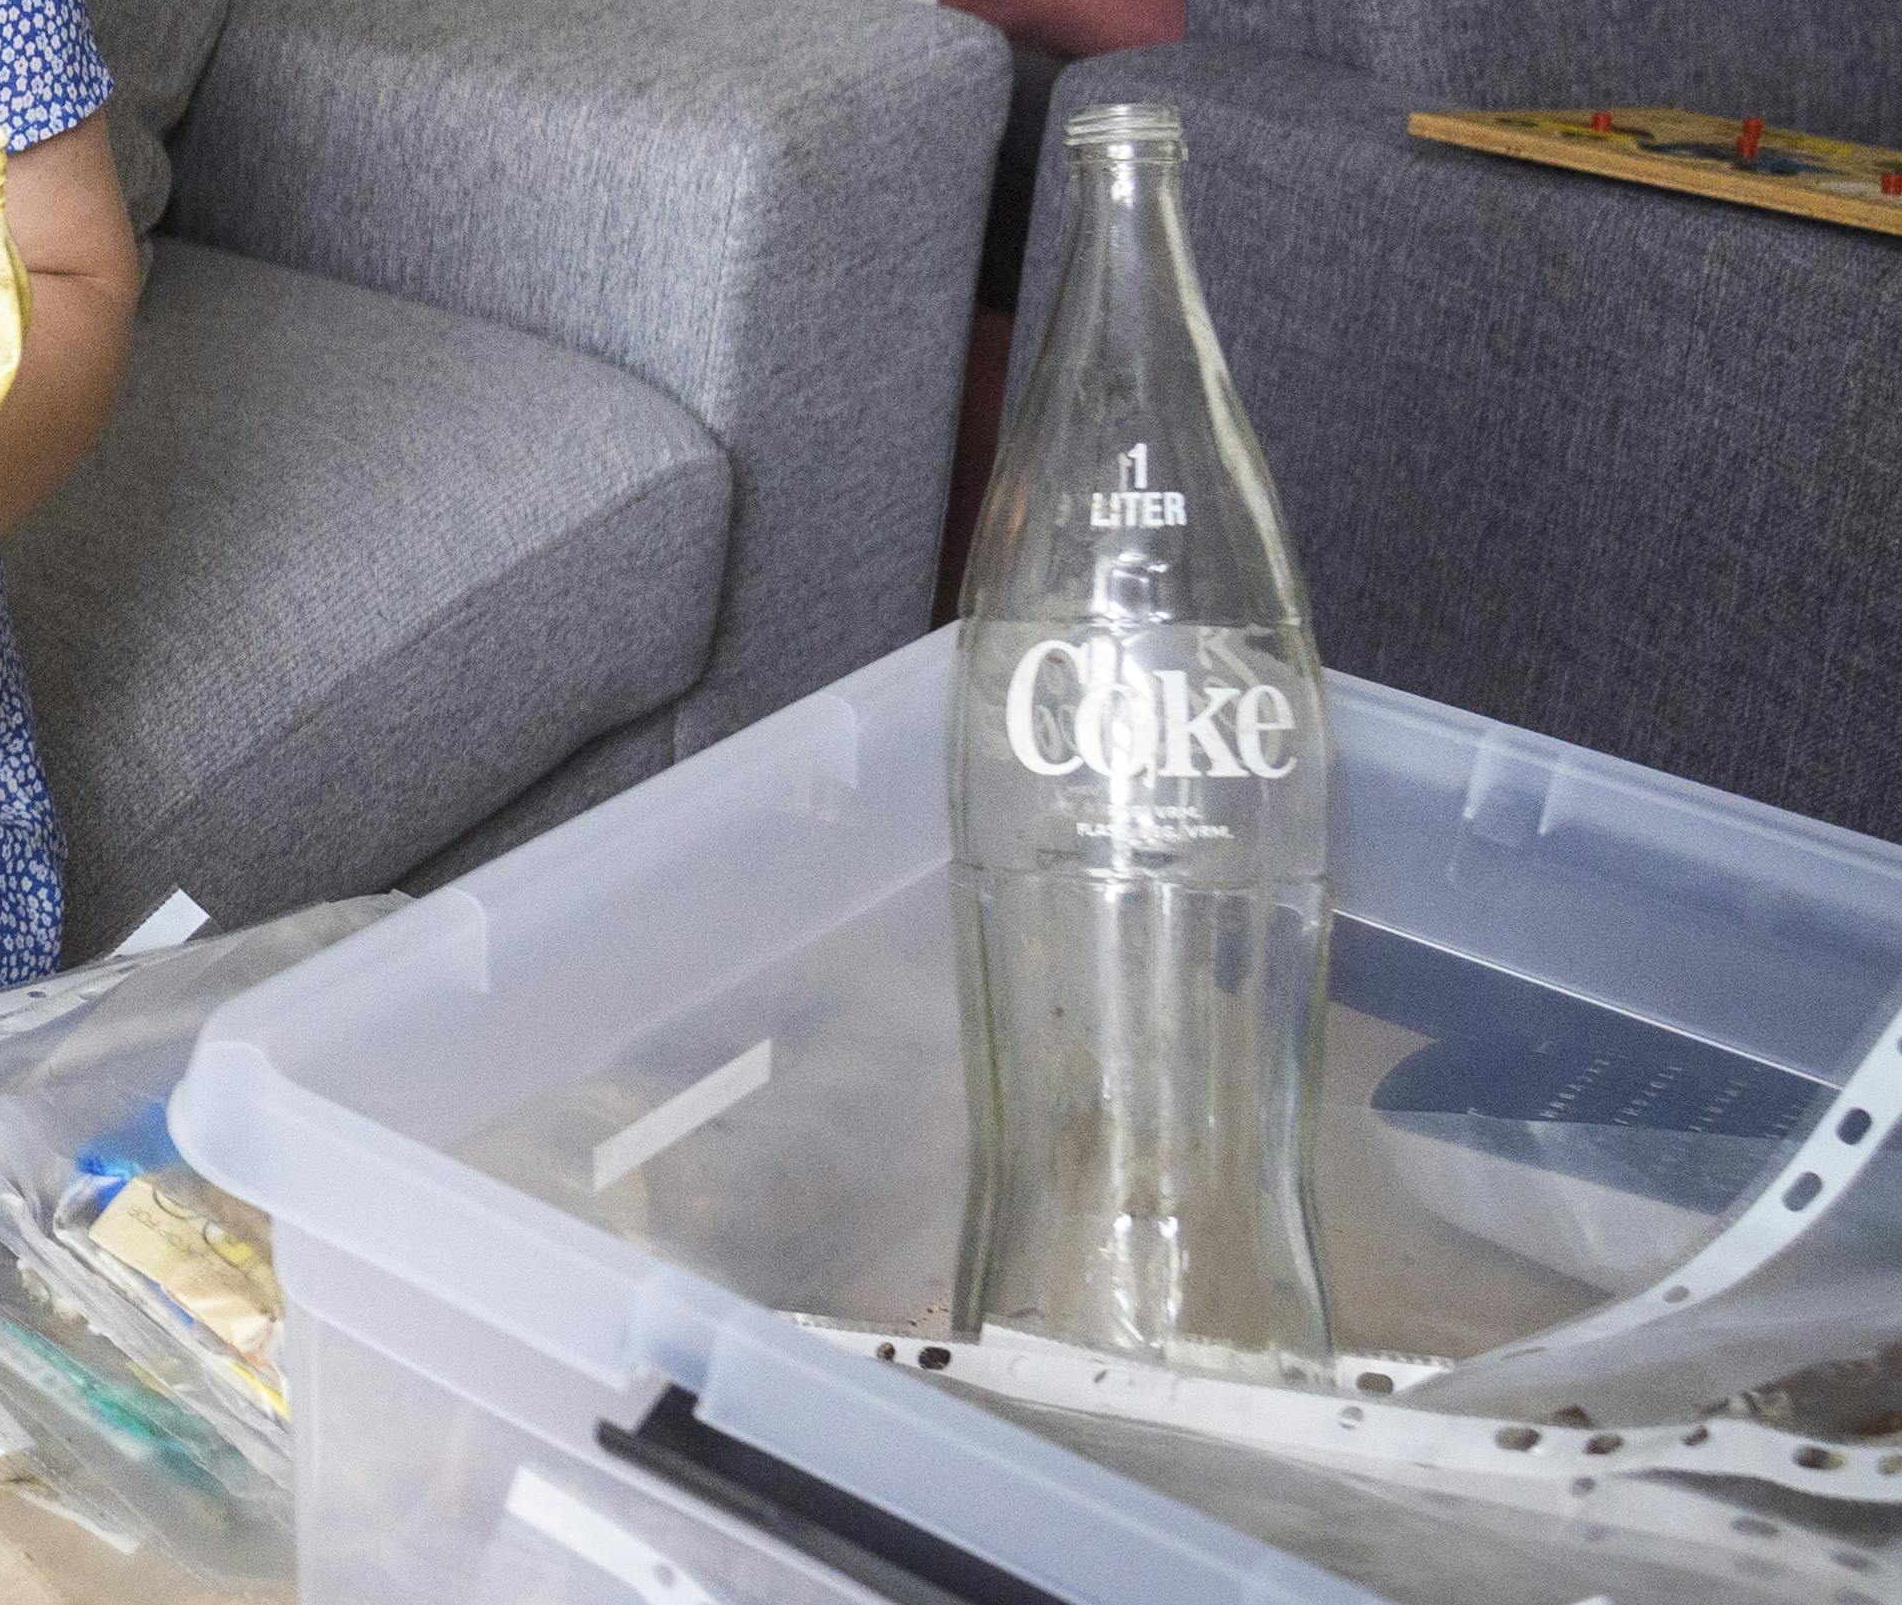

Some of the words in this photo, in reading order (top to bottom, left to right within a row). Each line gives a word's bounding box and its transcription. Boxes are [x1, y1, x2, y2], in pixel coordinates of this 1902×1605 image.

[1127, 442, 1148, 489] 1
[1090, 491, 1187, 527] LITER
[1006, 639, 1298, 780] Coke
